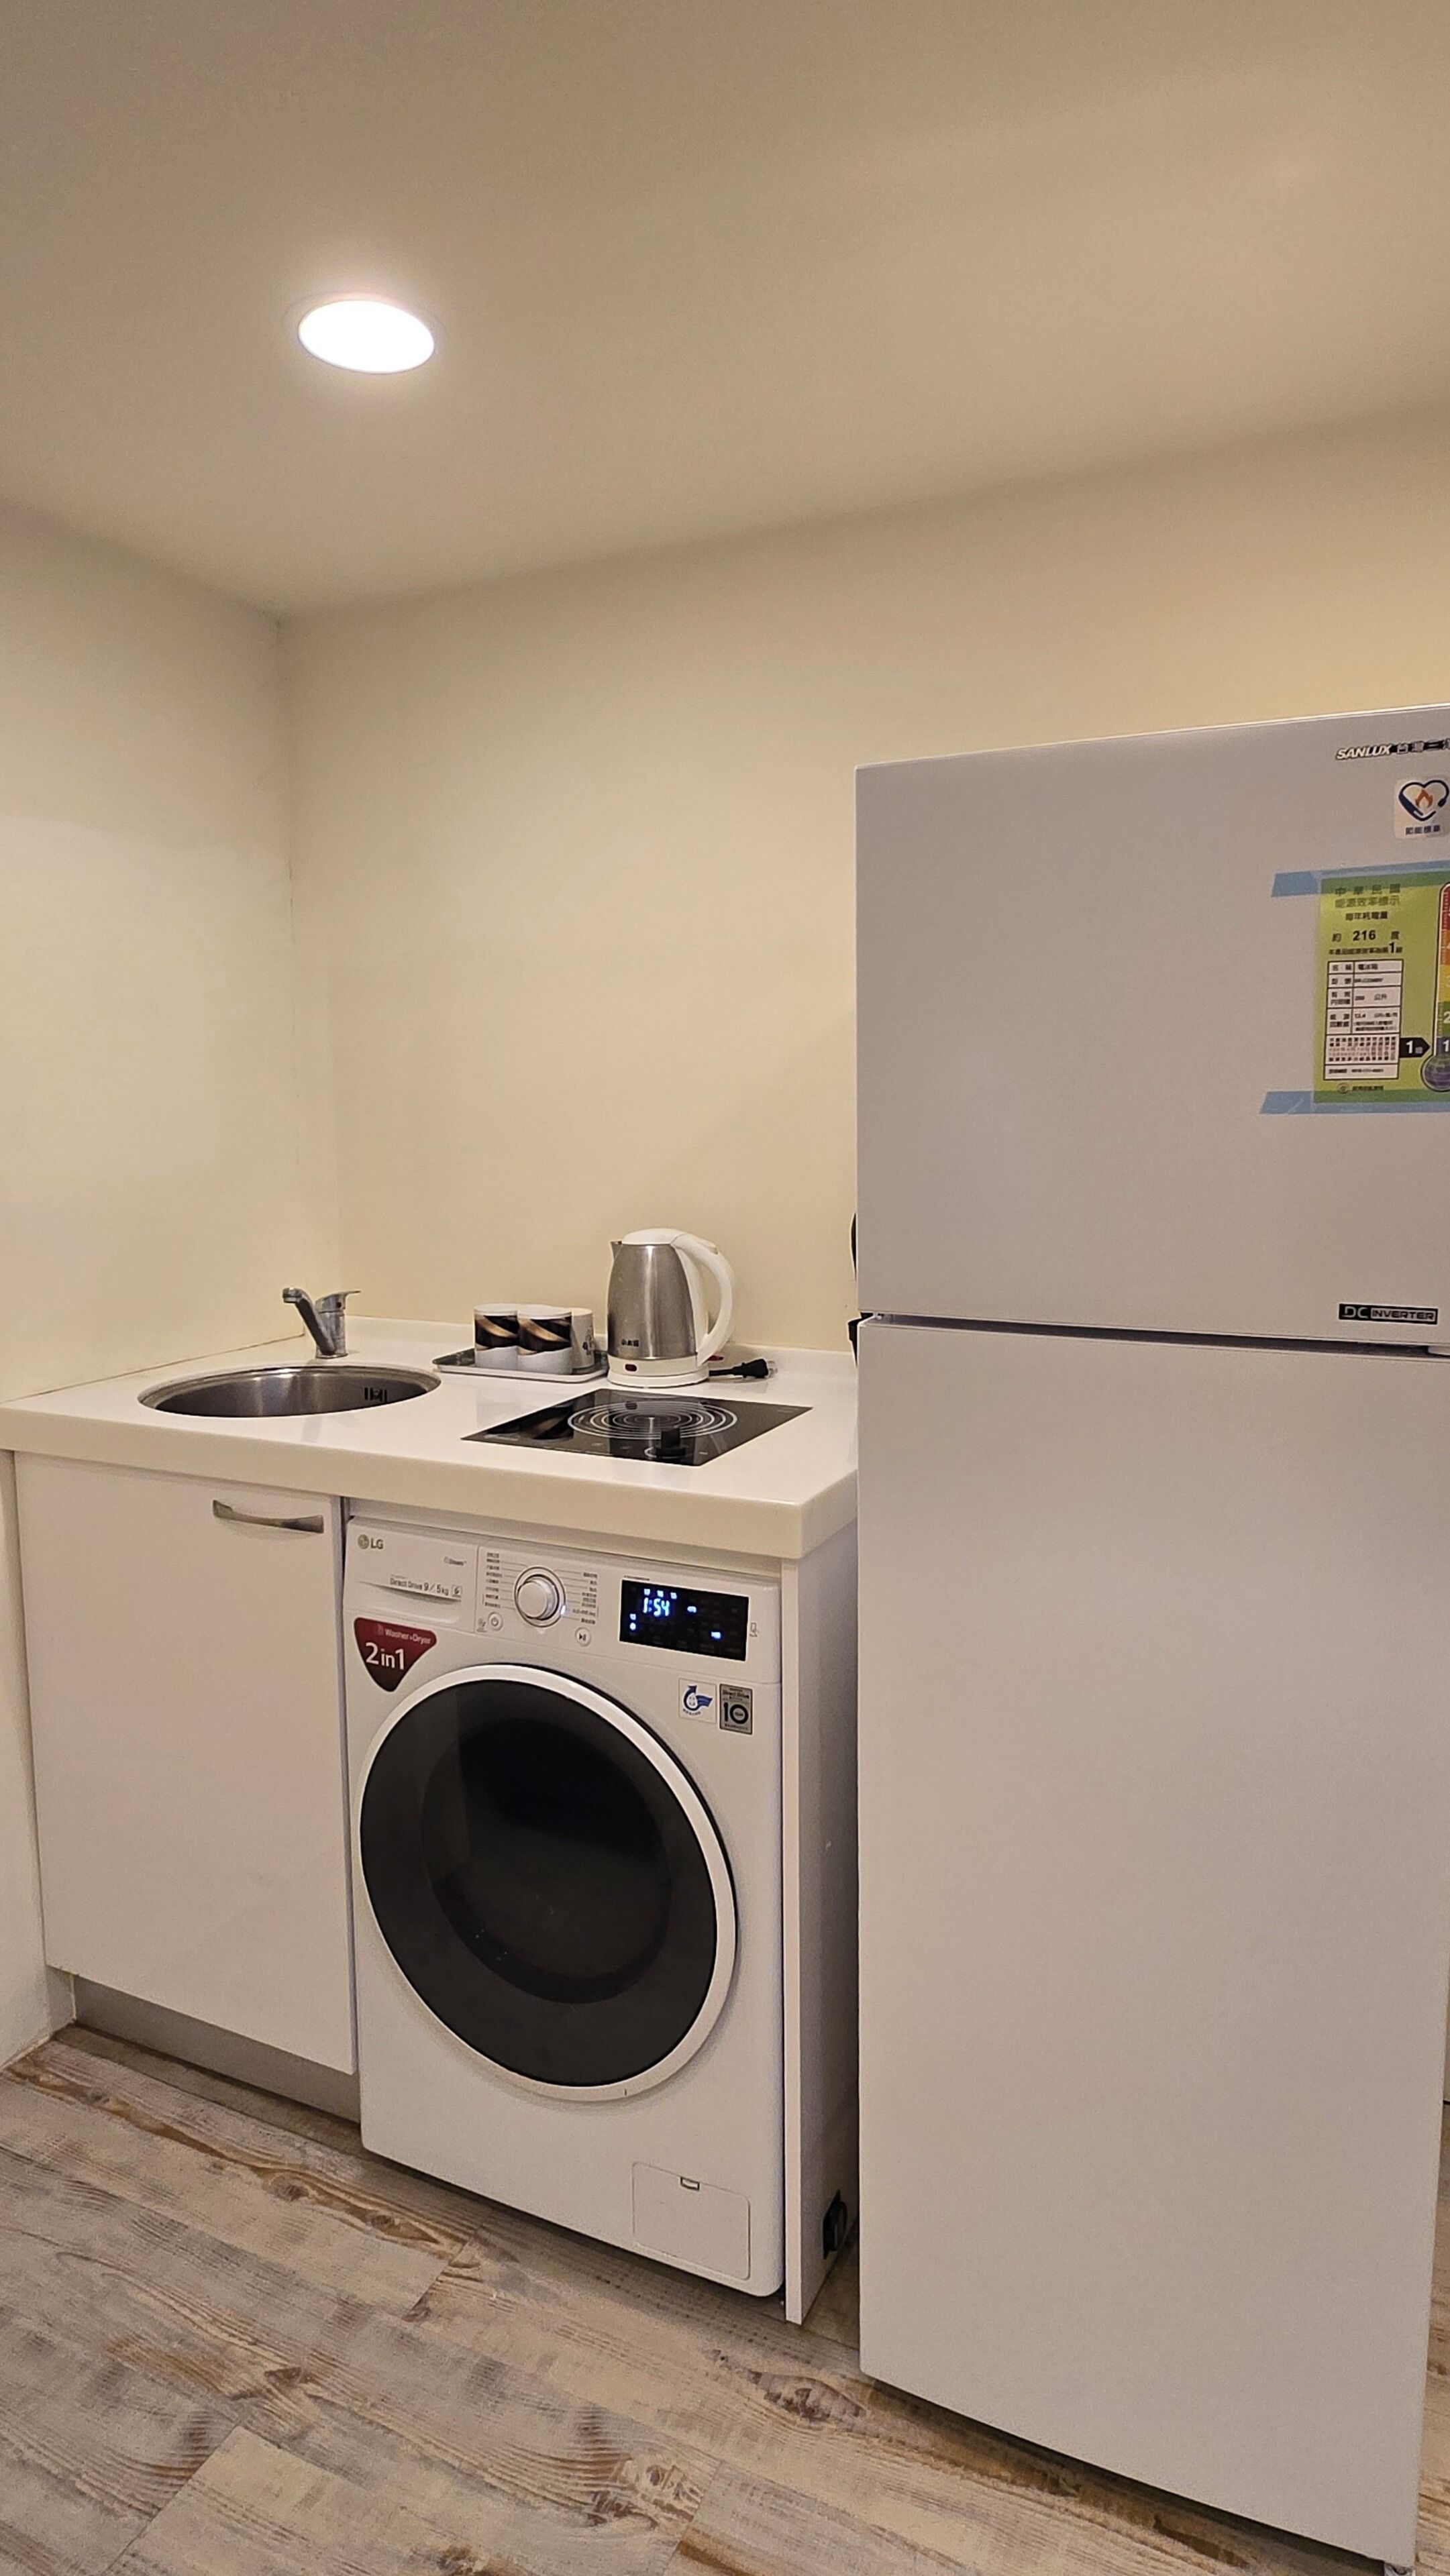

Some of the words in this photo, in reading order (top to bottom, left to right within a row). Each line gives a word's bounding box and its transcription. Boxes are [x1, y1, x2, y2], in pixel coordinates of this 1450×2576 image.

[1336, 743, 1392, 761] SANLUX
[1352, 930, 1376, 942] 216
[1342, 1305, 1369, 1319] DC
[1371, 1309, 1435, 1320] INVERTER
[370, 1538, 384, 1550] LG
[642, 1597, 670, 1617] 1:54
[723, 1702, 749, 1725] 10
